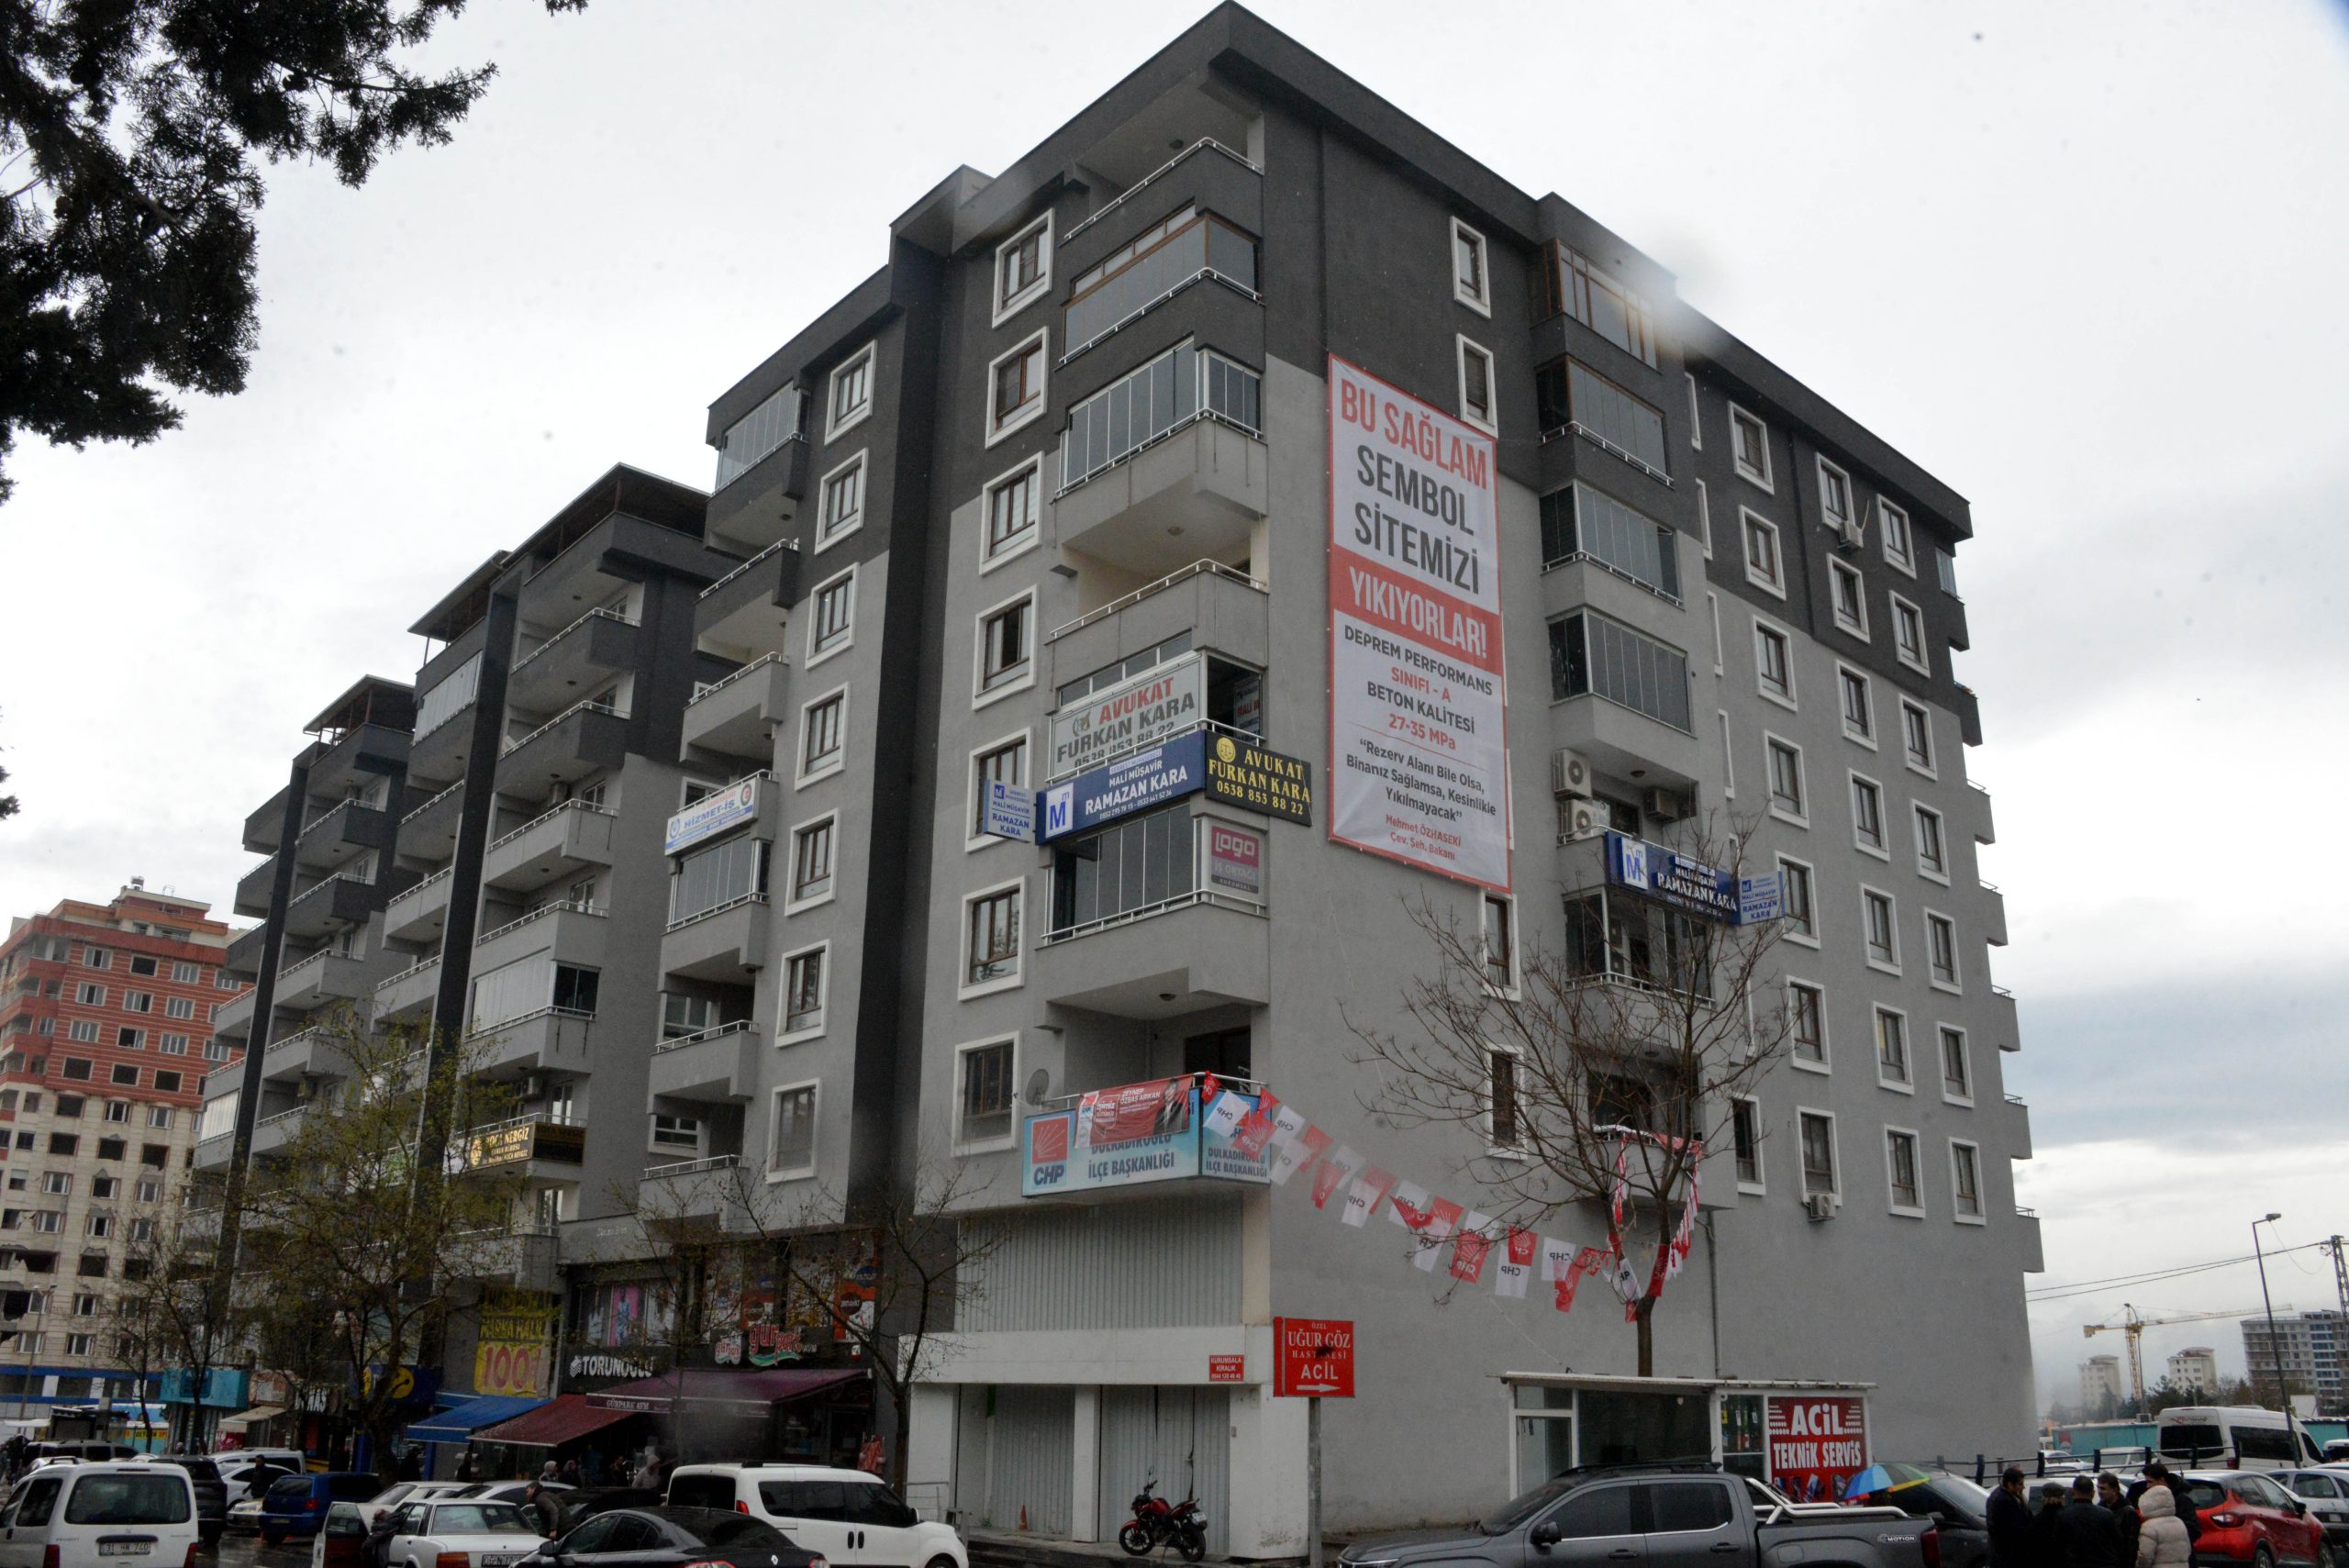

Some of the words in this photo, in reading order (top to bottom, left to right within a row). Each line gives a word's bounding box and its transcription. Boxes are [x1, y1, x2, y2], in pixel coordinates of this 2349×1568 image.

[1341, 378, 1375, 432] BU
[1385, 402, 1486, 490] SAĞLAM
[1357, 445, 1474, 536] SEMBOL
[1355, 502, 1479, 595] SİTEMİZİ
[1350, 565, 1486, 659] YIKIYORLAR!
[1344, 625, 1401, 660] DEPREM
[1405, 649, 1493, 695] PERFORMANS
[1099, 676, 1174, 724] AVUKAT
[1391, 666, 1430, 695] SINIFI
[1442, 687, 1451, 703] A
[1367, 681, 1414, 711] BETON
[1417, 700, 1475, 734] KALİTESİ
[1057, 717, 1132, 762] FURKAN
[1139, 692, 1195, 729] KARA
[1389, 714, 1425, 740] 27-35
[1430, 728, 1456, 751] MPa
[1109, 771, 1128, 788] MALİ
[1129, 760, 1163, 781] MÜŞAVİR
[1208, 759, 1267, 790] FURKAN
[1271, 777, 1310, 803] KARA
[1244, 750, 1303, 780] AVUKAT
[1407, 755, 1433, 775] Alanı
[1437, 767, 1457, 783] Bile
[1459, 773, 1485, 795] Olsa,
[1085, 780, 1147, 815] RAMAZAN
[1150, 765, 1188, 792] KARA
[1217, 780, 1243, 797] 0538
[1248, 789, 1268, 805] 853
[1272, 796, 1286, 809] 88
[1290, 802, 1303, 815] 22
[1346, 754, 1389, 778] Binanız
[1391, 769, 1445, 801] Sağlamsa,
[1448, 788, 1497, 816] Kesinlikle
[992, 813, 1030, 828] RAMAZAN
[1000, 825, 1020, 836] KARA
[1386, 814, 1419, 834] Mehmet
[1419, 824, 1462, 847] ÖZHASEKİ
[1215, 832, 1255, 858] logo
[1390, 832, 1408, 845] Çev.
[1409, 837, 1427, 851] Şeh.
[1429, 844, 1455, 861] Bakanı
[1657, 872, 1708, 902] RAMAZAN
[1709, 888, 1737, 912] KARA
[1743, 900, 1776, 912] RAMAZAN
[1751, 910, 1770, 919] KARA
[505, 1127, 529, 1143] NERGİZ
[1033, 1164, 1064, 1185] CHP
[1088, 1161, 1108, 1182] İLÇE
[1111, 1150, 1174, 1178] BAŞKANLIĞI
[1206, 1158, 1221, 1173] İLÇE
[1223, 1162, 1267, 1177] BAŞKANLIĞI
[1287, 1329, 1323, 1347] UĞUR
[1325, 1330, 1351, 1349] GÖZ
[1311, 1321, 1328, 1329] ÖZEL
[1300, 1362, 1339, 1380] ACİL
[607, 1397, 636, 1409] GÜRPARK
